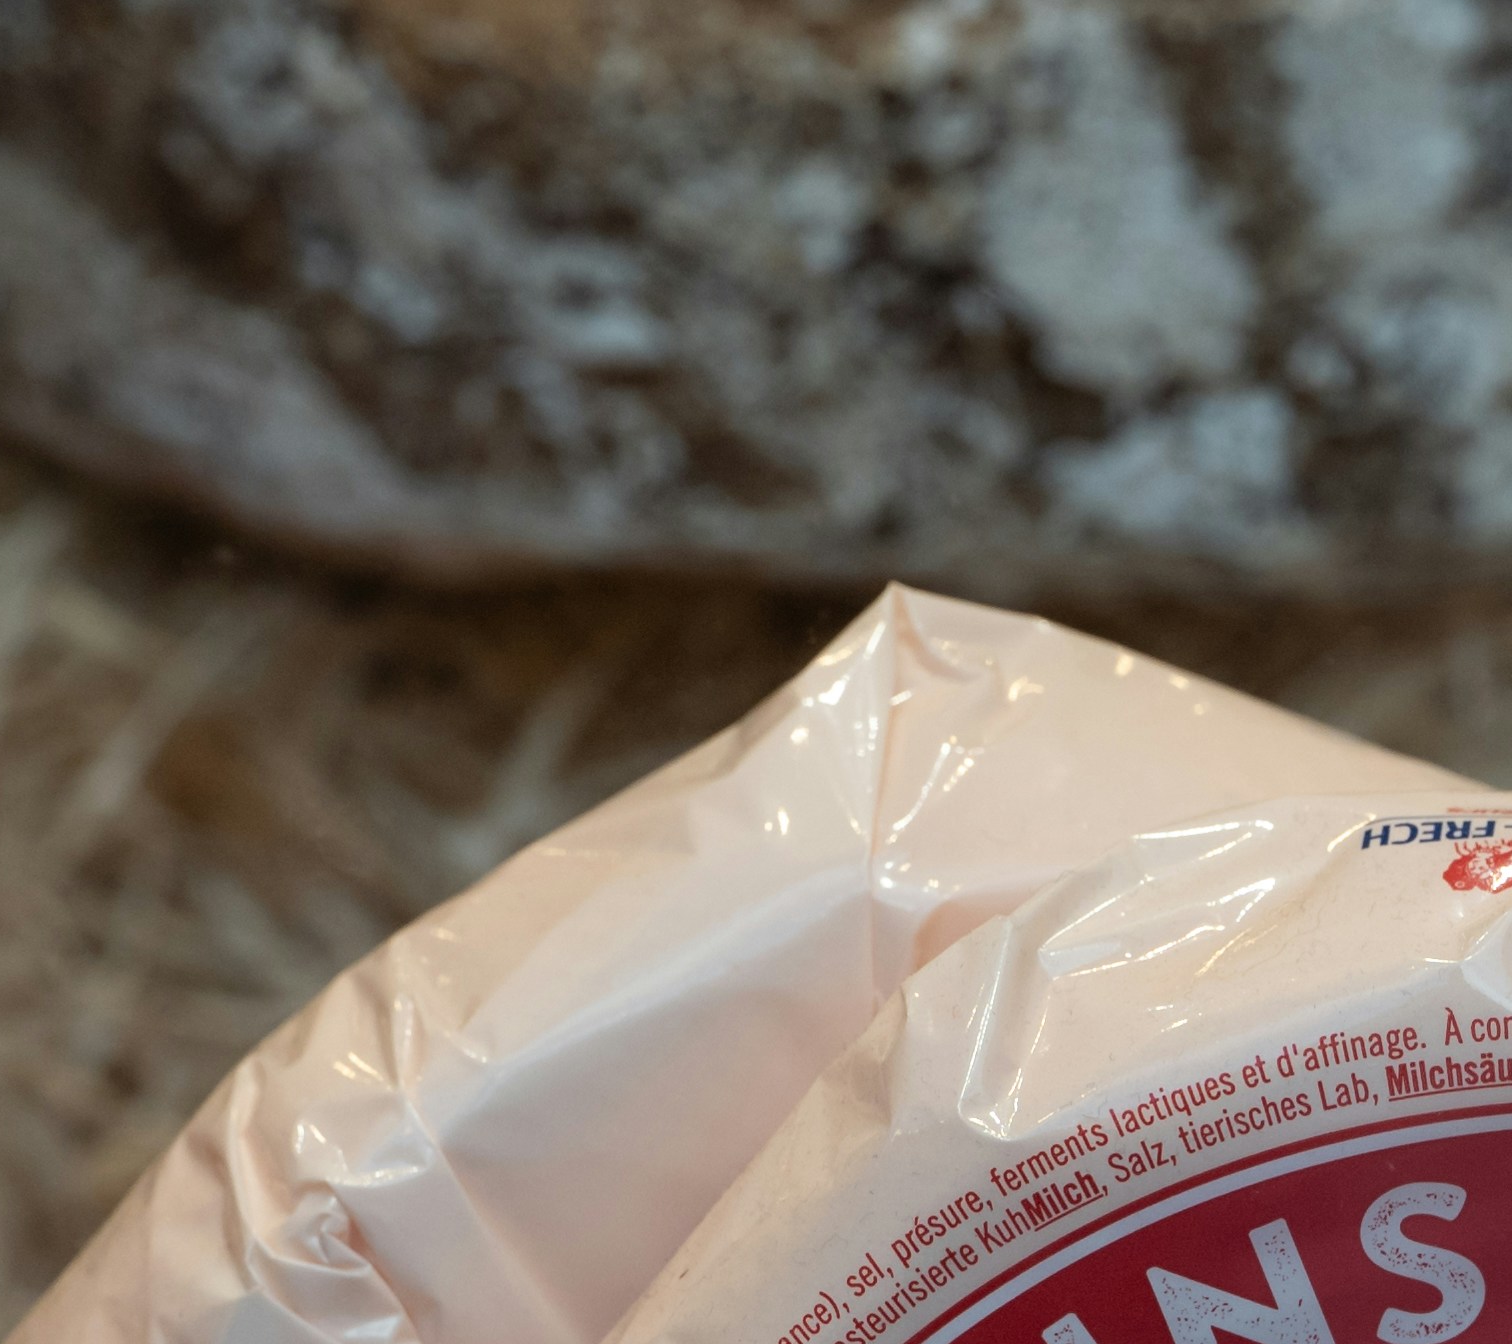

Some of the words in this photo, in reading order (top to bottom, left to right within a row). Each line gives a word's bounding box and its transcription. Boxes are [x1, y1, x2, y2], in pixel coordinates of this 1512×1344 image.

[1360, 819, 1496, 851] FRECH
[846, 1252, 895, 1297] sel,
[890, 1189, 994, 1269] présure,
[990, 1123, 1109, 1197] ferments
[1109, 1071, 1236, 1137] lactiques
[1241, 1054, 1271, 1088] et
[1276, 1026, 1427, 1078] d'affinage.
[1444, 1007, 1463, 1046] À
[975, 1171, 1109, 1254] KuhMilch,
[1107, 1139, 1178, 1183] Salz,
[1178, 1092, 1312, 1154] tierisches
[1317, 1072, 1380, 1113] Lab,
